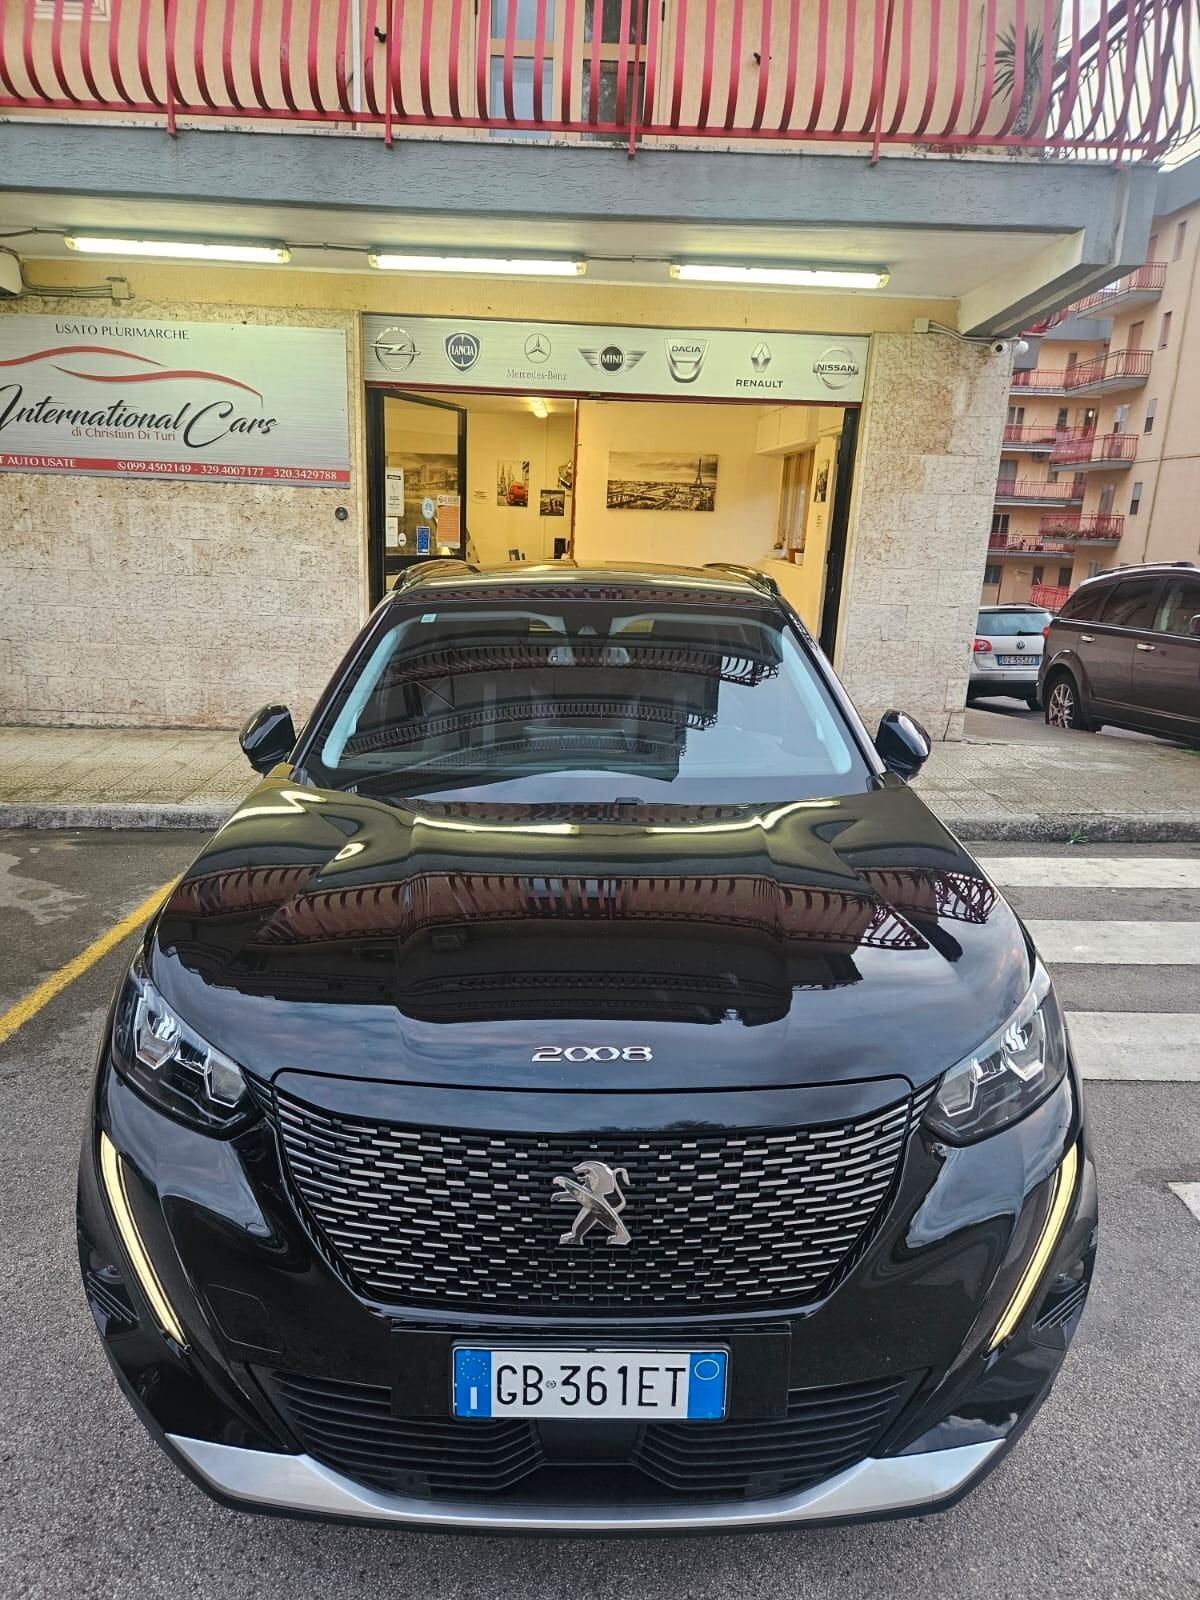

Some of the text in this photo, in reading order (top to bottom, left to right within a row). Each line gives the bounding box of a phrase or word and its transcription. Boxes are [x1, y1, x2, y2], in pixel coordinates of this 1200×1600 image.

[55, 323, 190, 340] USATO PLURIMARCHE
[451, 345, 475, 357] LANCIA
[671, 345, 702, 354] DACIA
[601, 354, 623, 365] MINI
[816, 363, 856, 372] NISSAN
[506, 369, 568, 381] Mercedes-Benz
[735, 379, 784, 389] RENAULT
[0, 384, 278, 449] International Cars
[71, 427, 176, 441] di Christian Di Turi
[8, 456, 39, 466] AUTO
[42, 459, 77, 468] USATE
[127, 460, 191, 473] 099.4502149
[200, 465, 263, 477] 329.4007177
[273, 469, 337, 481] 320.3429788
[531, 1046, 653, 1062] 2008
[496, 1364, 544, 1406] GB
[559, 1364, 687, 1407] 361ET
